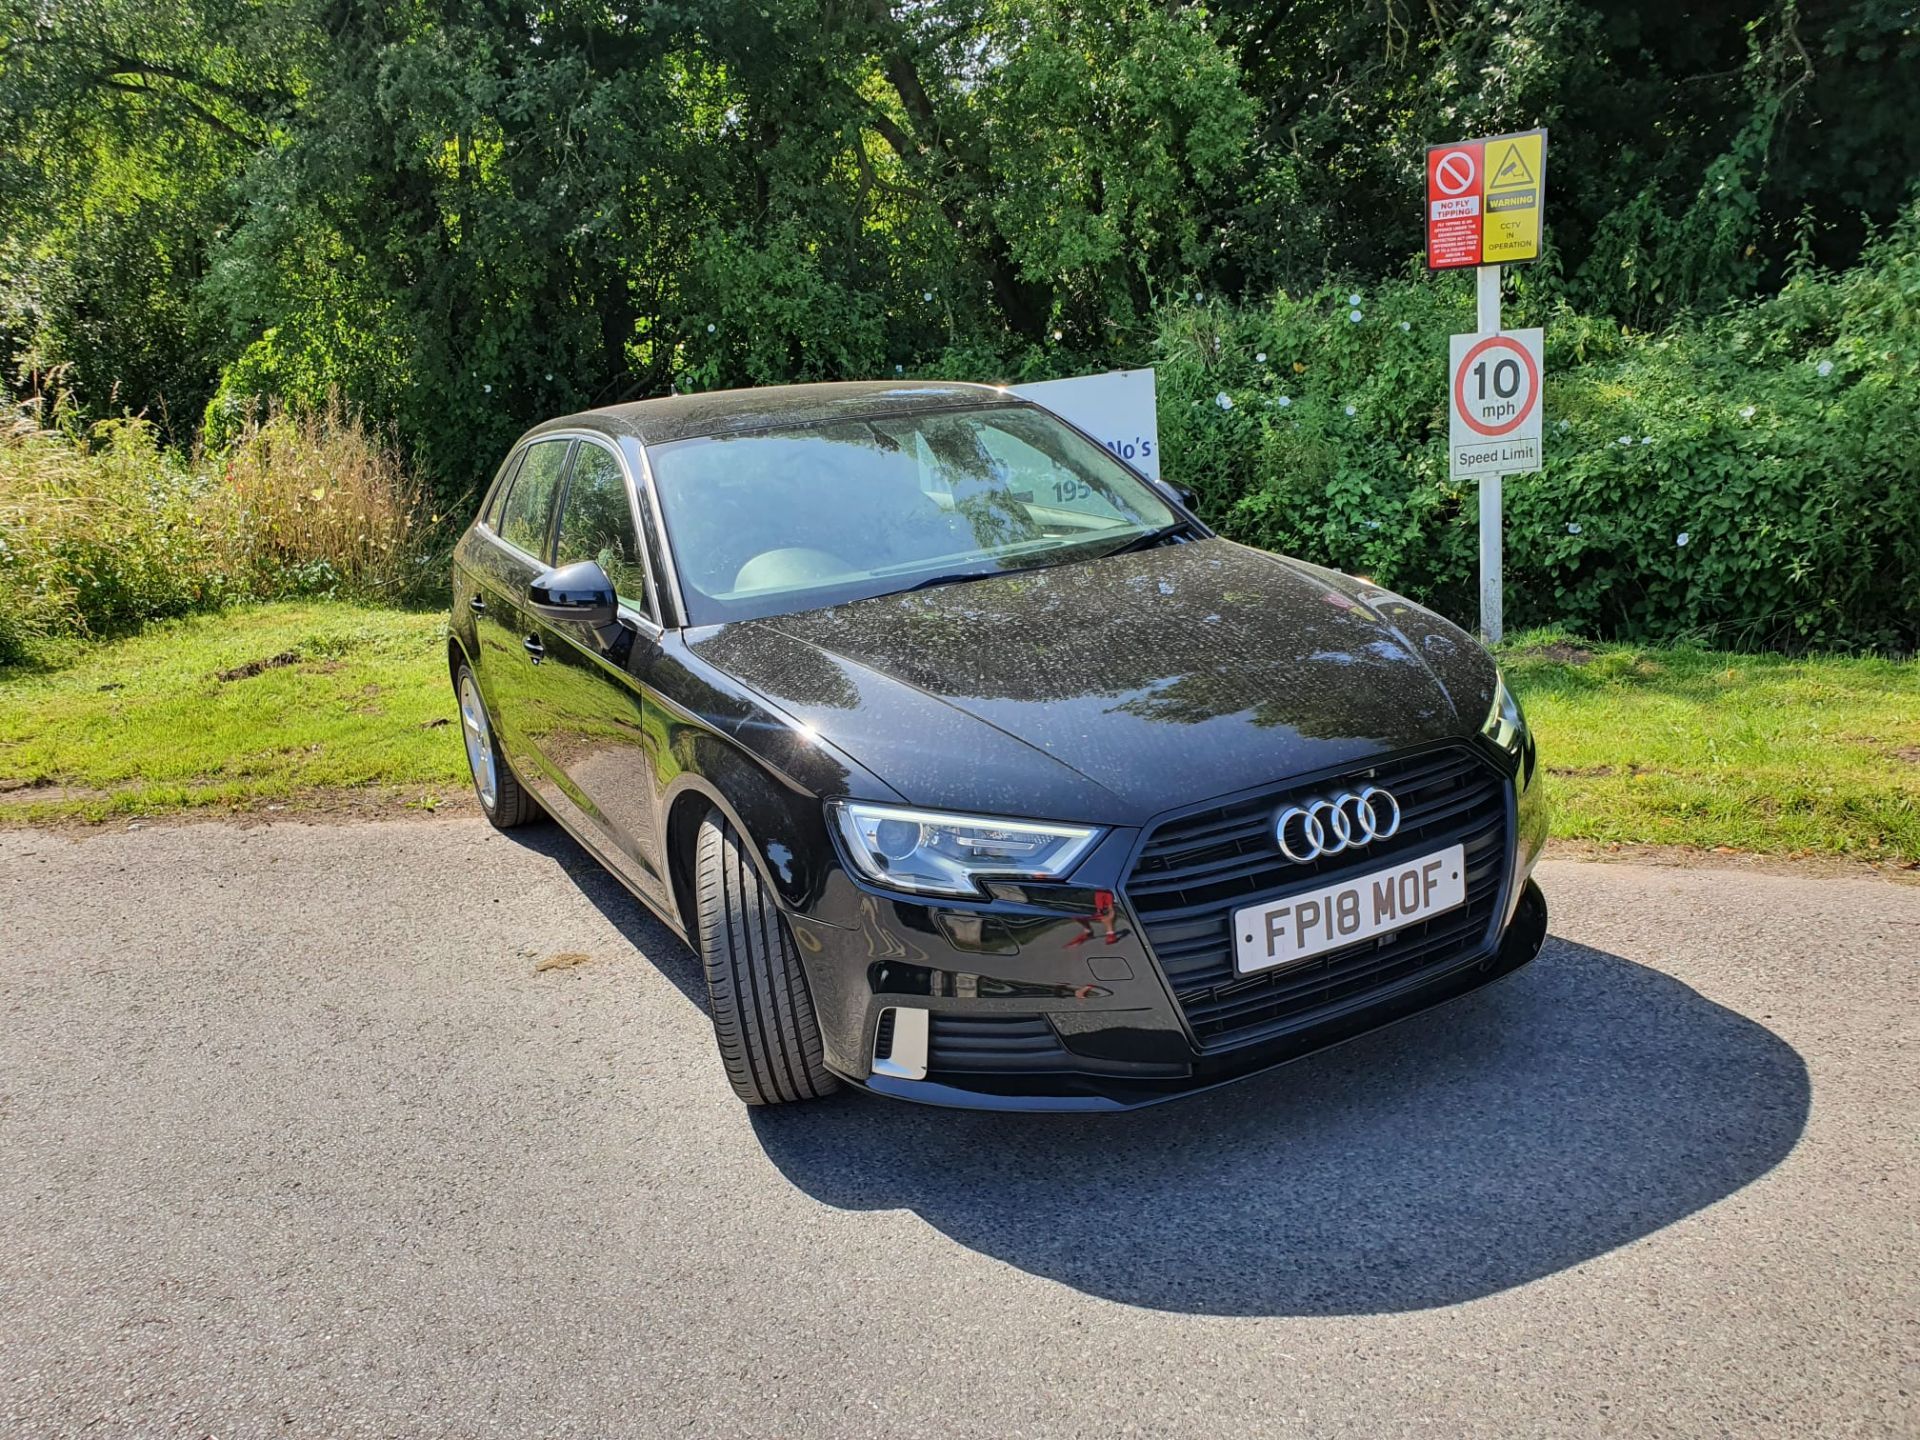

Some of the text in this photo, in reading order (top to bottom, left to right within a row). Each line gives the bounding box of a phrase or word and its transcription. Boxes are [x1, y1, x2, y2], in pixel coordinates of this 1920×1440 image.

[1440, 200, 1470, 210] NO FLY
[1490, 196, 1533, 209] WARNING
[1438, 208, 1473, 218] TIPPING!
[1500, 221, 1521, 230] CCTV
[1488, 240, 1532, 251] OPERATION
[1473, 358, 1521, 401] 10
[1482, 401, 1516, 421] mph
[1459, 446, 1534, 468] Speed Limit
[1264, 860, 1443, 957] FP18 MOF
